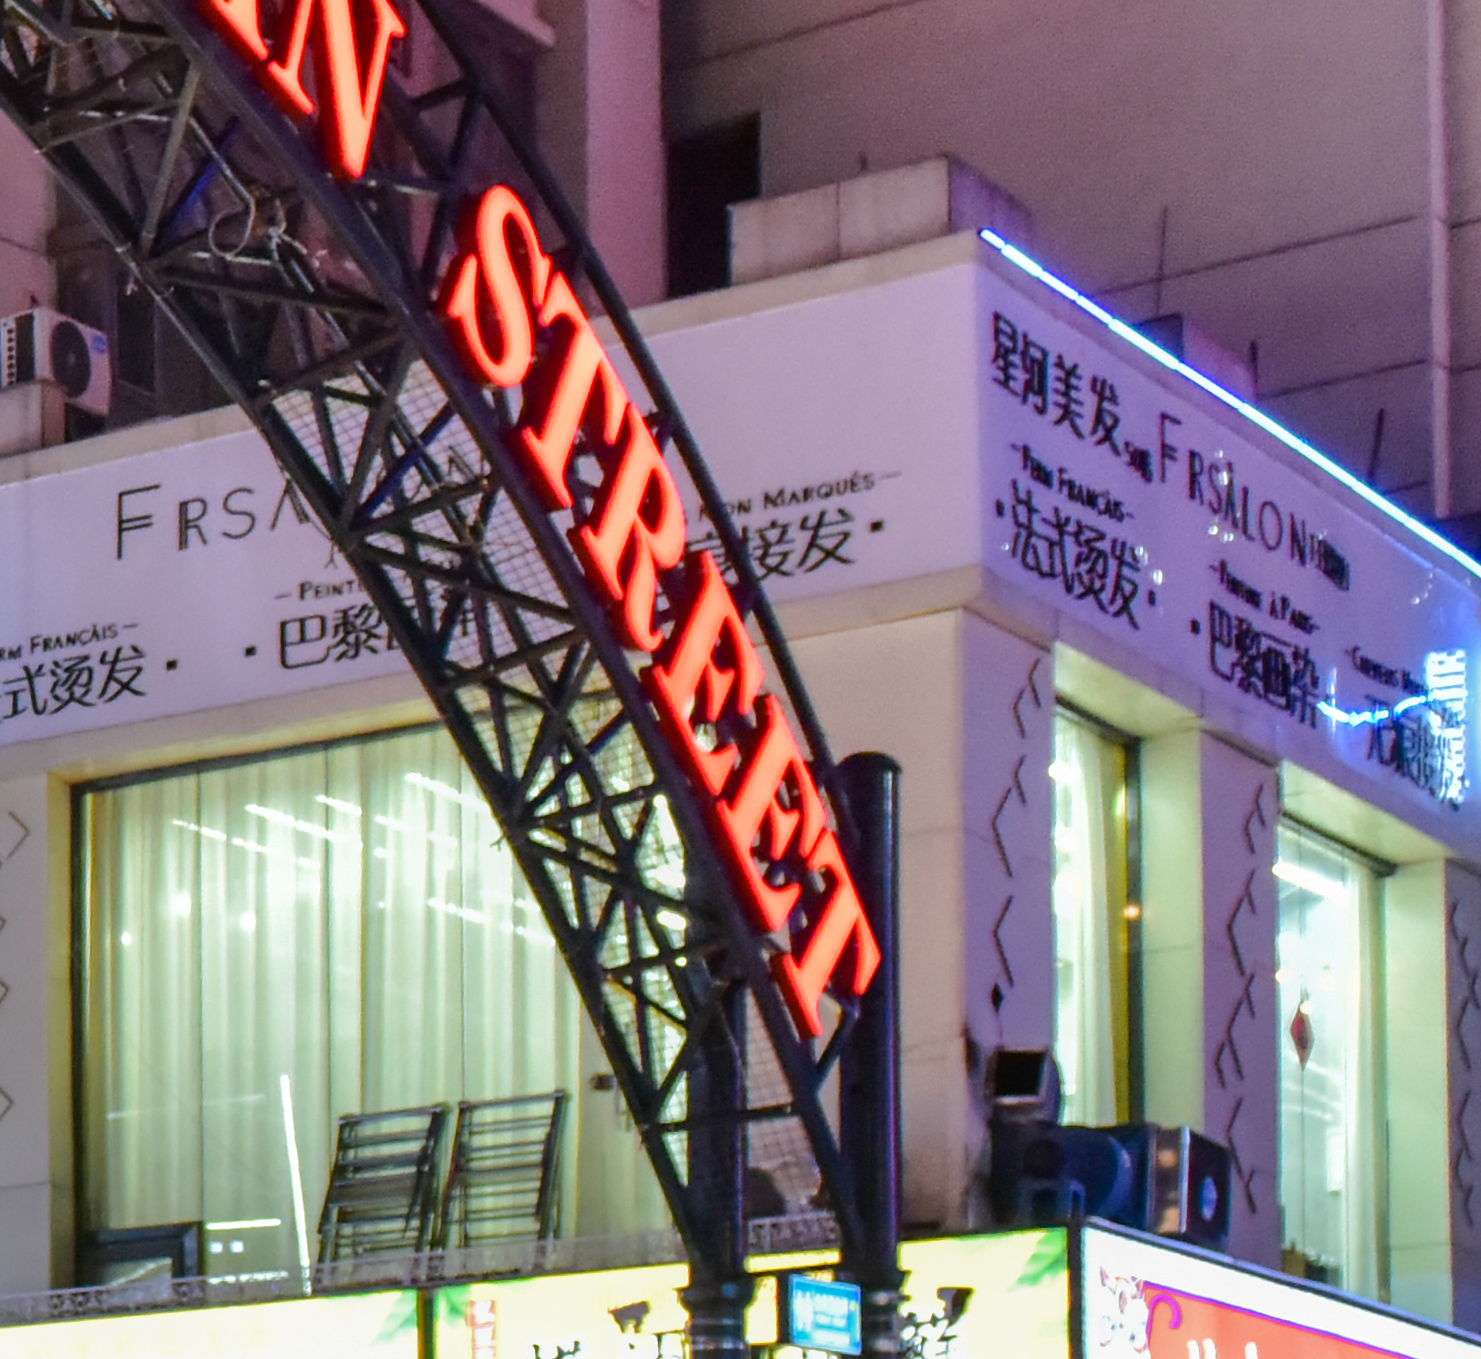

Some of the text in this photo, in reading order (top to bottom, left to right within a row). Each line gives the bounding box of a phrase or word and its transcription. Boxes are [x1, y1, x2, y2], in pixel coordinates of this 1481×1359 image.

[446, 184, 883, 1038] STREET
[1011, 478, 1141, 631] 法式烫发
